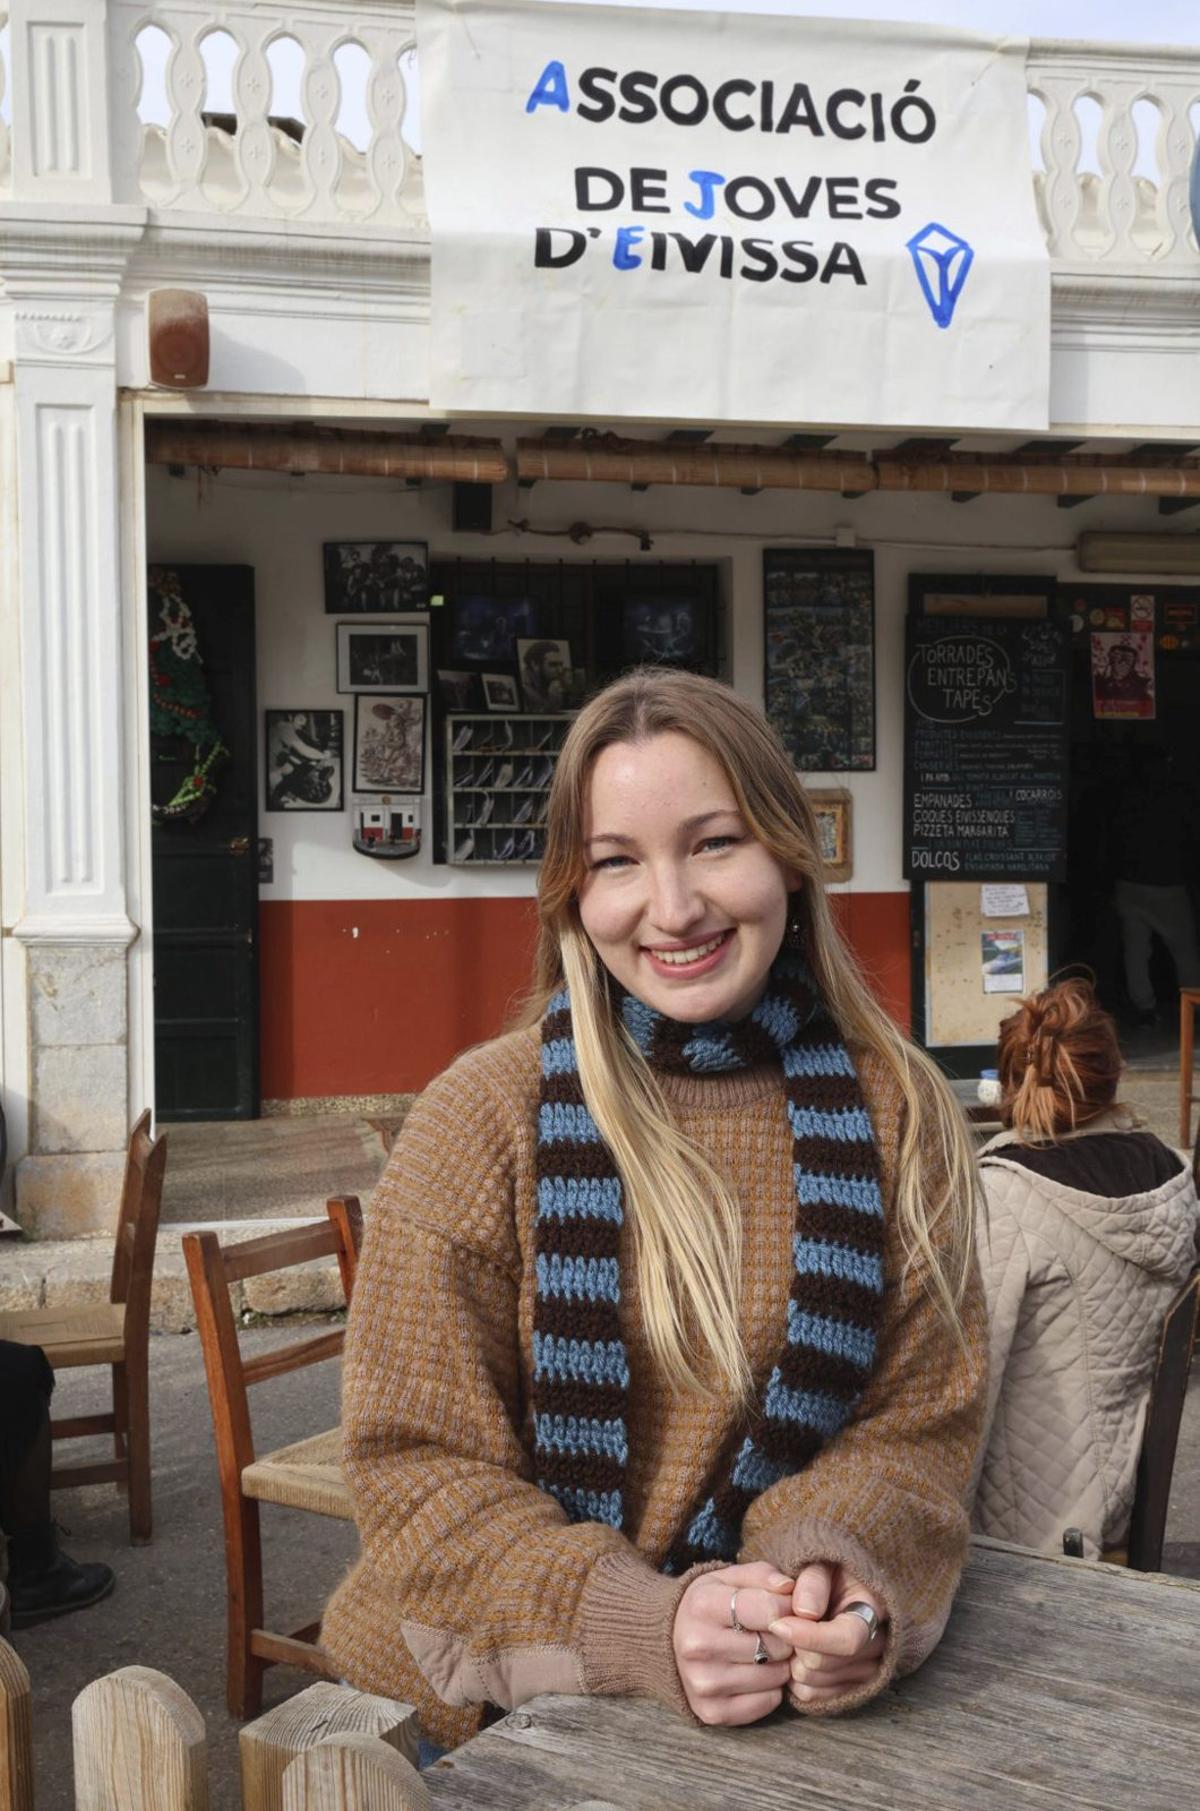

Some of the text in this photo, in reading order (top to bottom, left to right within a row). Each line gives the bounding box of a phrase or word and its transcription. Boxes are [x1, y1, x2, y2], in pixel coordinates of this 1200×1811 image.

[526, 60, 937, 144] ASSOCIACIÓ
[574, 166, 902, 221] DE JOVES
[915, 644, 994, 668] TORRADES
[927, 667, 1018, 693] ENTREPANS
[942, 688, 994, 716] TAPES
[914, 793, 973, 808] EMPANADES
[912, 809, 1016, 823] COQUES EIVISSENQUES
[913, 824, 954, 838] PIZZETA
